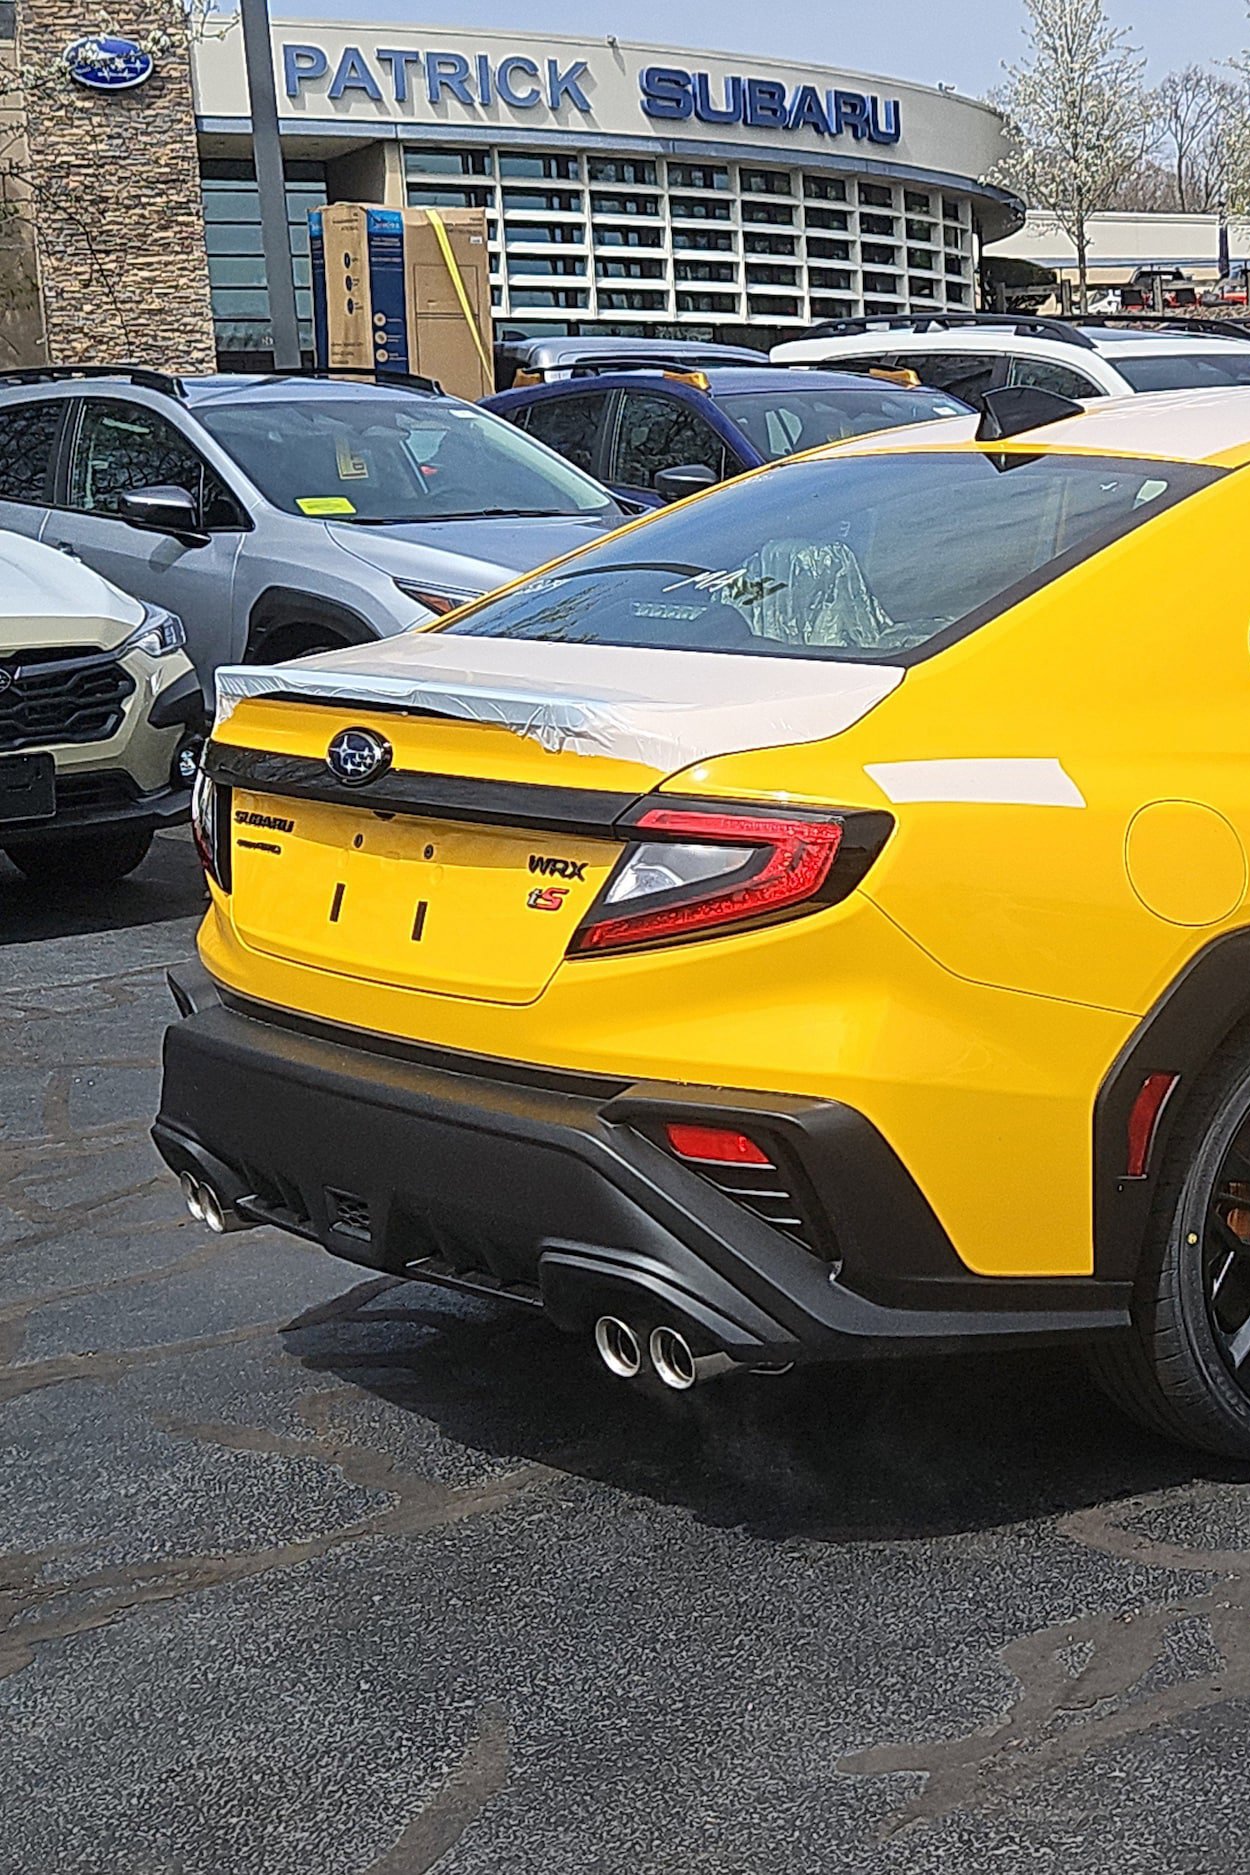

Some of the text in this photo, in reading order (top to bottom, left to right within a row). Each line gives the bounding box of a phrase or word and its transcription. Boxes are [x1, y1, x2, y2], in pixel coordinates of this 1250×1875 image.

[282, 43, 901, 145] PATRICK SUBARU
[528, 854, 590, 882] WRX
